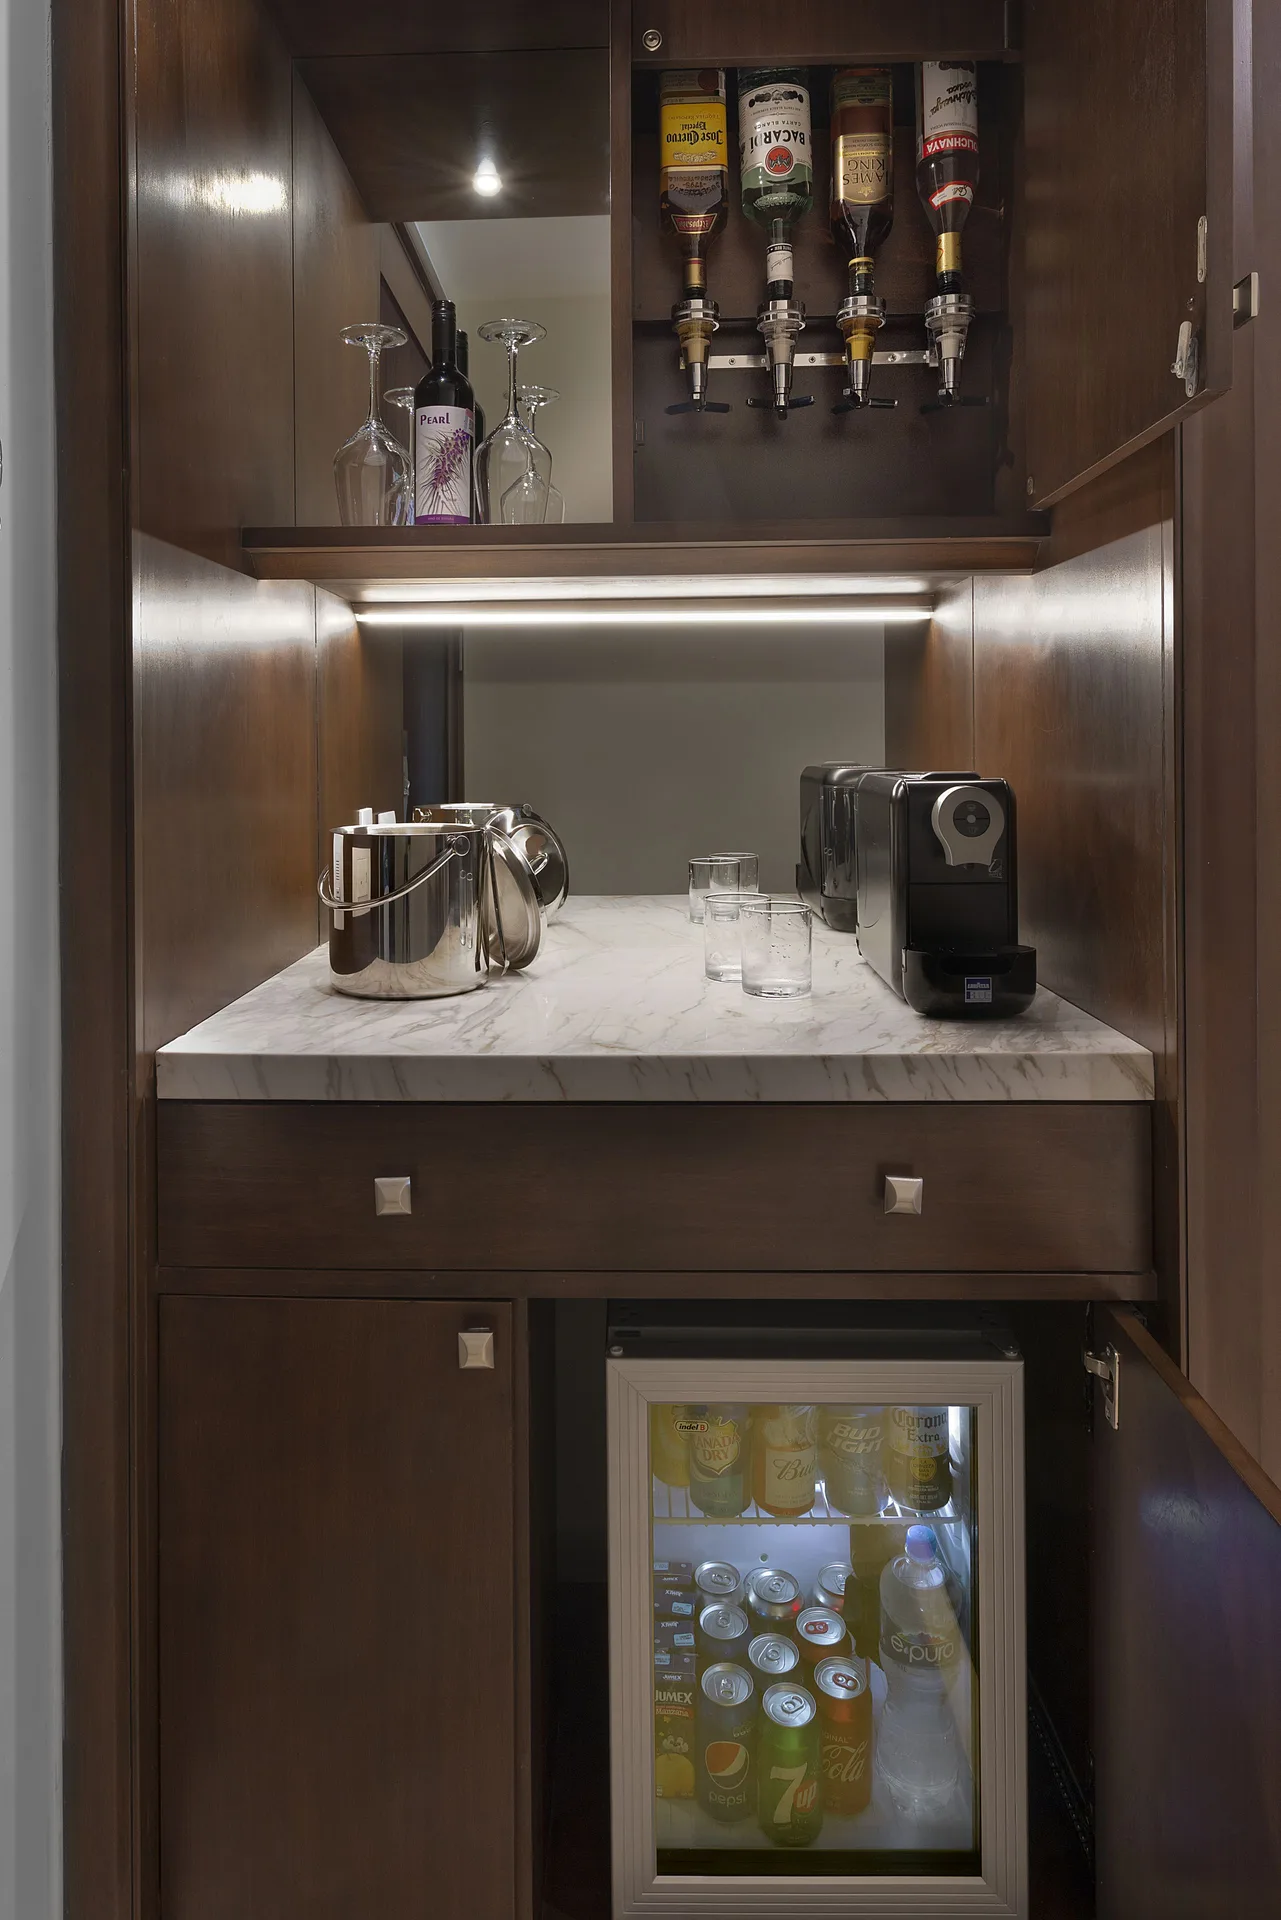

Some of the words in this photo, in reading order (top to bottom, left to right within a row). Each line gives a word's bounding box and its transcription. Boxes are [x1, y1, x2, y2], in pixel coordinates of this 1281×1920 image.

[781, 119, 802, 128] CARTA
[665, 129, 700, 147] Cuervo
[701, 129, 724, 147] Jose
[748, 129, 806, 154] BACARDÍ
[847, 158, 886, 172] KING
[842, 171, 889, 187] JAMES
[420, 412, 451, 426] PEARL
[678, 1422, 698, 1432] indel
[699, 1423, 706, 1432] B
[833, 1422, 881, 1440] BUD
[905, 1427, 941, 1443] Extra
[703, 1449, 731, 1462] DRY
[654, 1689, 693, 1705] JUMEX
[708, 1790, 747, 1808] pepsi
[769, 1761, 808, 1824] 7
